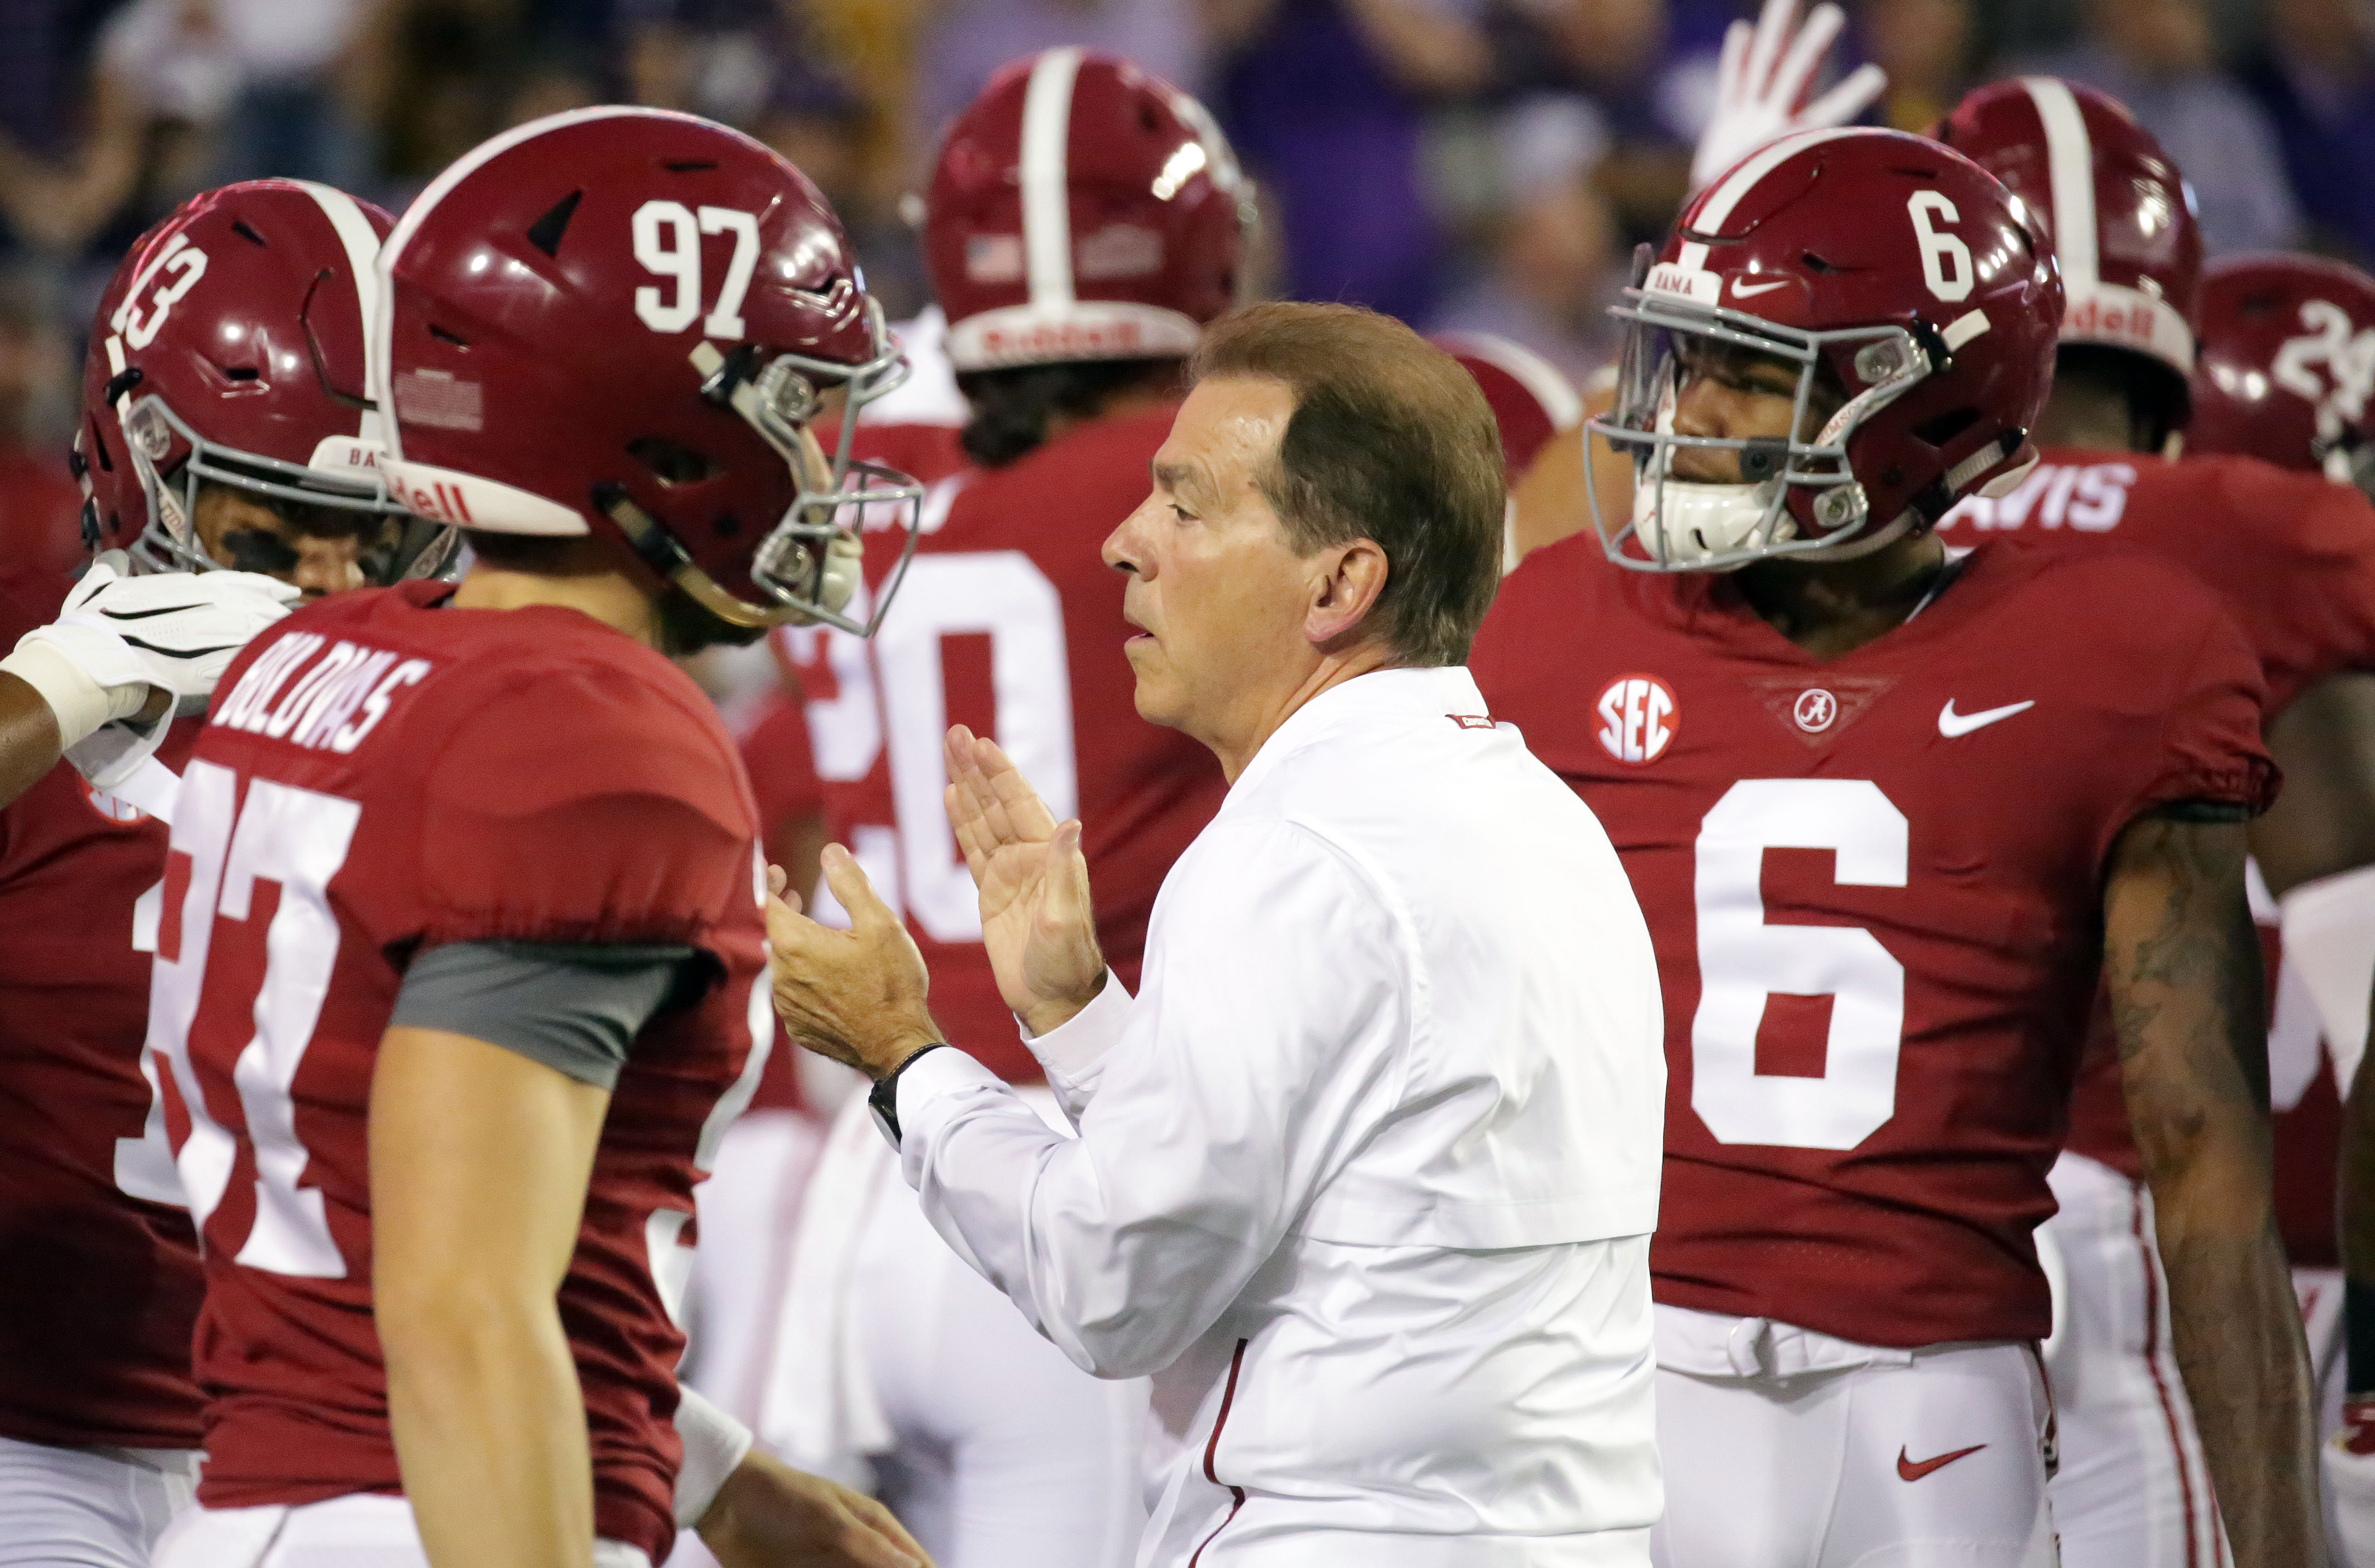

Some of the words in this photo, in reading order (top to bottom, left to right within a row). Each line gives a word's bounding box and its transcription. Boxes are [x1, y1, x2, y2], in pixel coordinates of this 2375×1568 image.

[111, 233, 208, 351] 13
[632, 201, 760, 340] 97
[1908, 190, 1975, 302] 6
[349, 448, 377, 468] BA
[1933, 463, 2138, 533] AVIS
[1598, 678, 1673, 762] SEC
[1691, 778, 1909, 1151] 6
